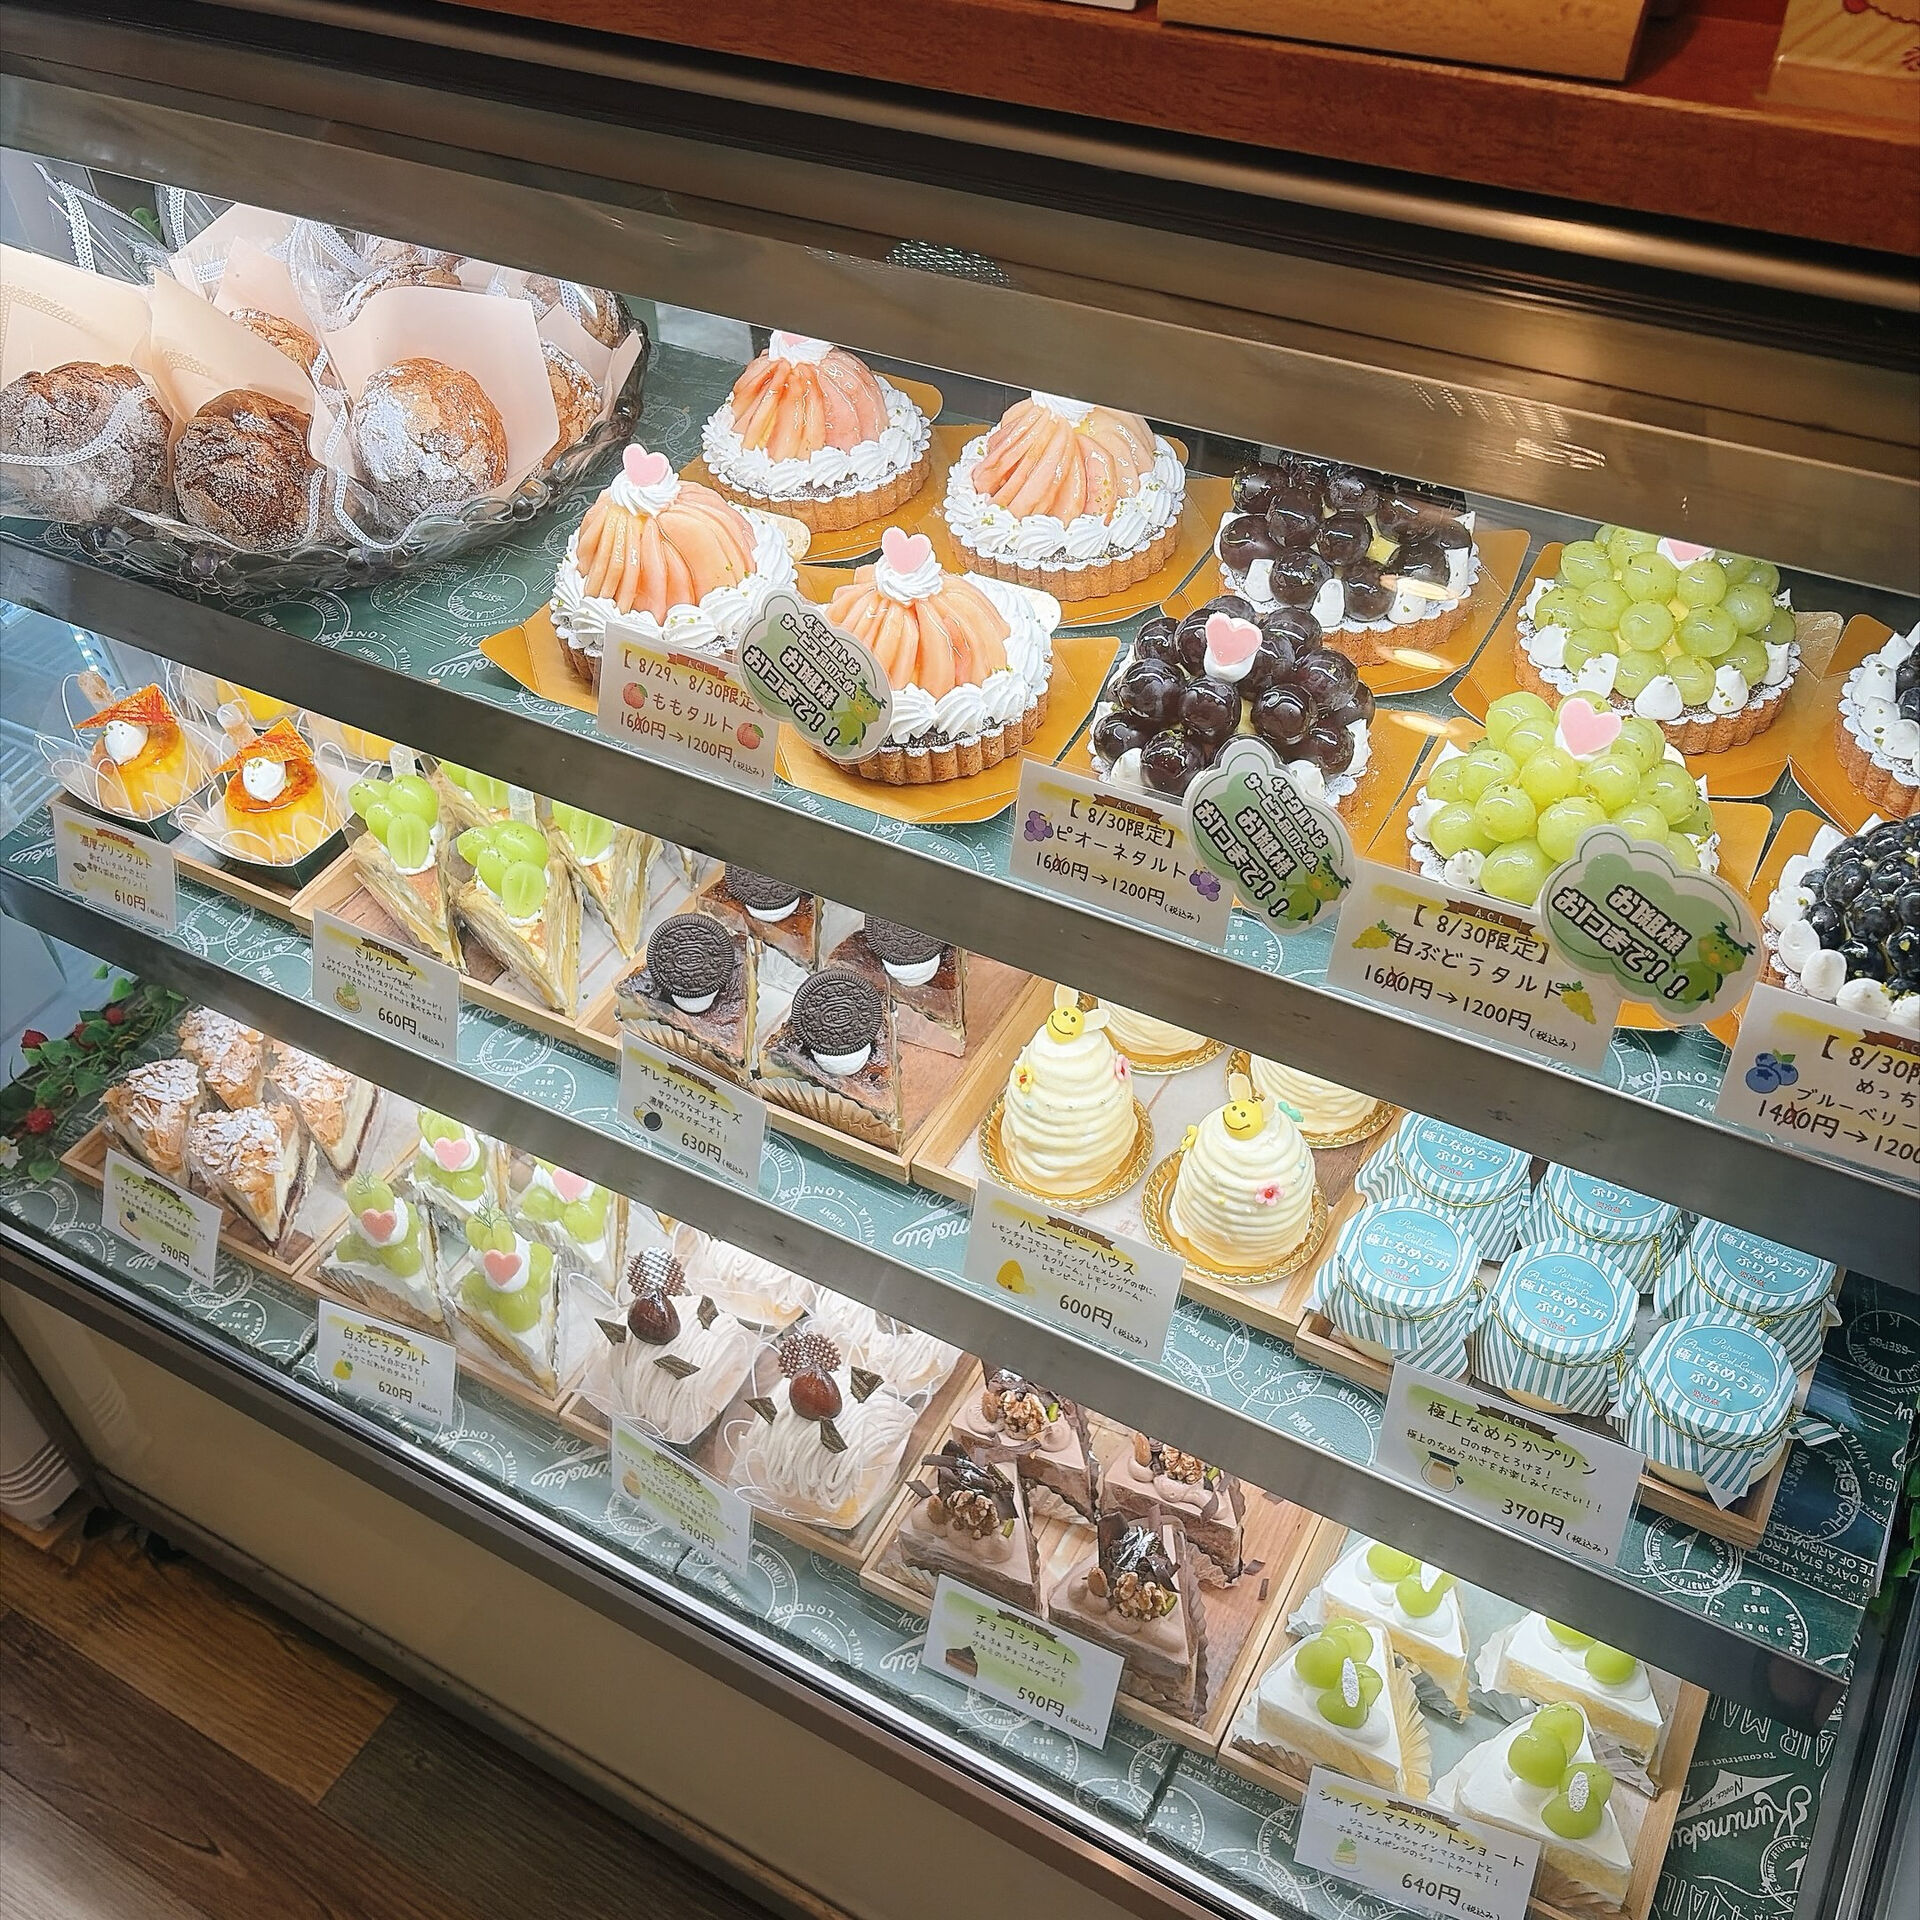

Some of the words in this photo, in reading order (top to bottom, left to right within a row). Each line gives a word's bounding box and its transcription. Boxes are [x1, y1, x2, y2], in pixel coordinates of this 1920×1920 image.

[652, 692, 735, 732] ももタルト
[688, 735, 733, 763] 1200円
[1054, 825, 1187, 880] ピオーネタルト
[114, 886, 146, 912] 610円
[1112, 877, 1165, 907] 1200円
[354, 945, 416, 982] ミルクレープ
[1393, 931, 1563, 1000] 白ぶどうタルト
[378, 1005, 416, 1035] 660円
[1462, 997, 1532, 1030] 1200円
[639, 1060, 743, 1127] オレオバスクチーズ
[681, 1128, 721, 1164] 630円
[160, 1240, 189, 1268] 590円
[1019, 1217, 1137, 1277] ハニービーハウス
[1721, 1232, 1809, 1278] 極上なめらか
[1058, 1291, 1113, 1330] 600円
[343, 1324, 430, 1369] 白ぶどうタルト
[378, 1379, 412, 1403] 620円
[1674, 1347, 1766, 1398] 極上なめらか
[1427, 1400, 1597, 1476] 極上なめらかプリン
[679, 1516, 715, 1551] 590円
[1501, 1498, 1565, 1536] 370円
[974, 1612, 1074, 1667] チョコショート
[1016, 1683, 1064, 1719] 590円
[1316, 1787, 1526, 1870] シャインマスカットショート
[1400, 1871, 1462, 1907] 640円
